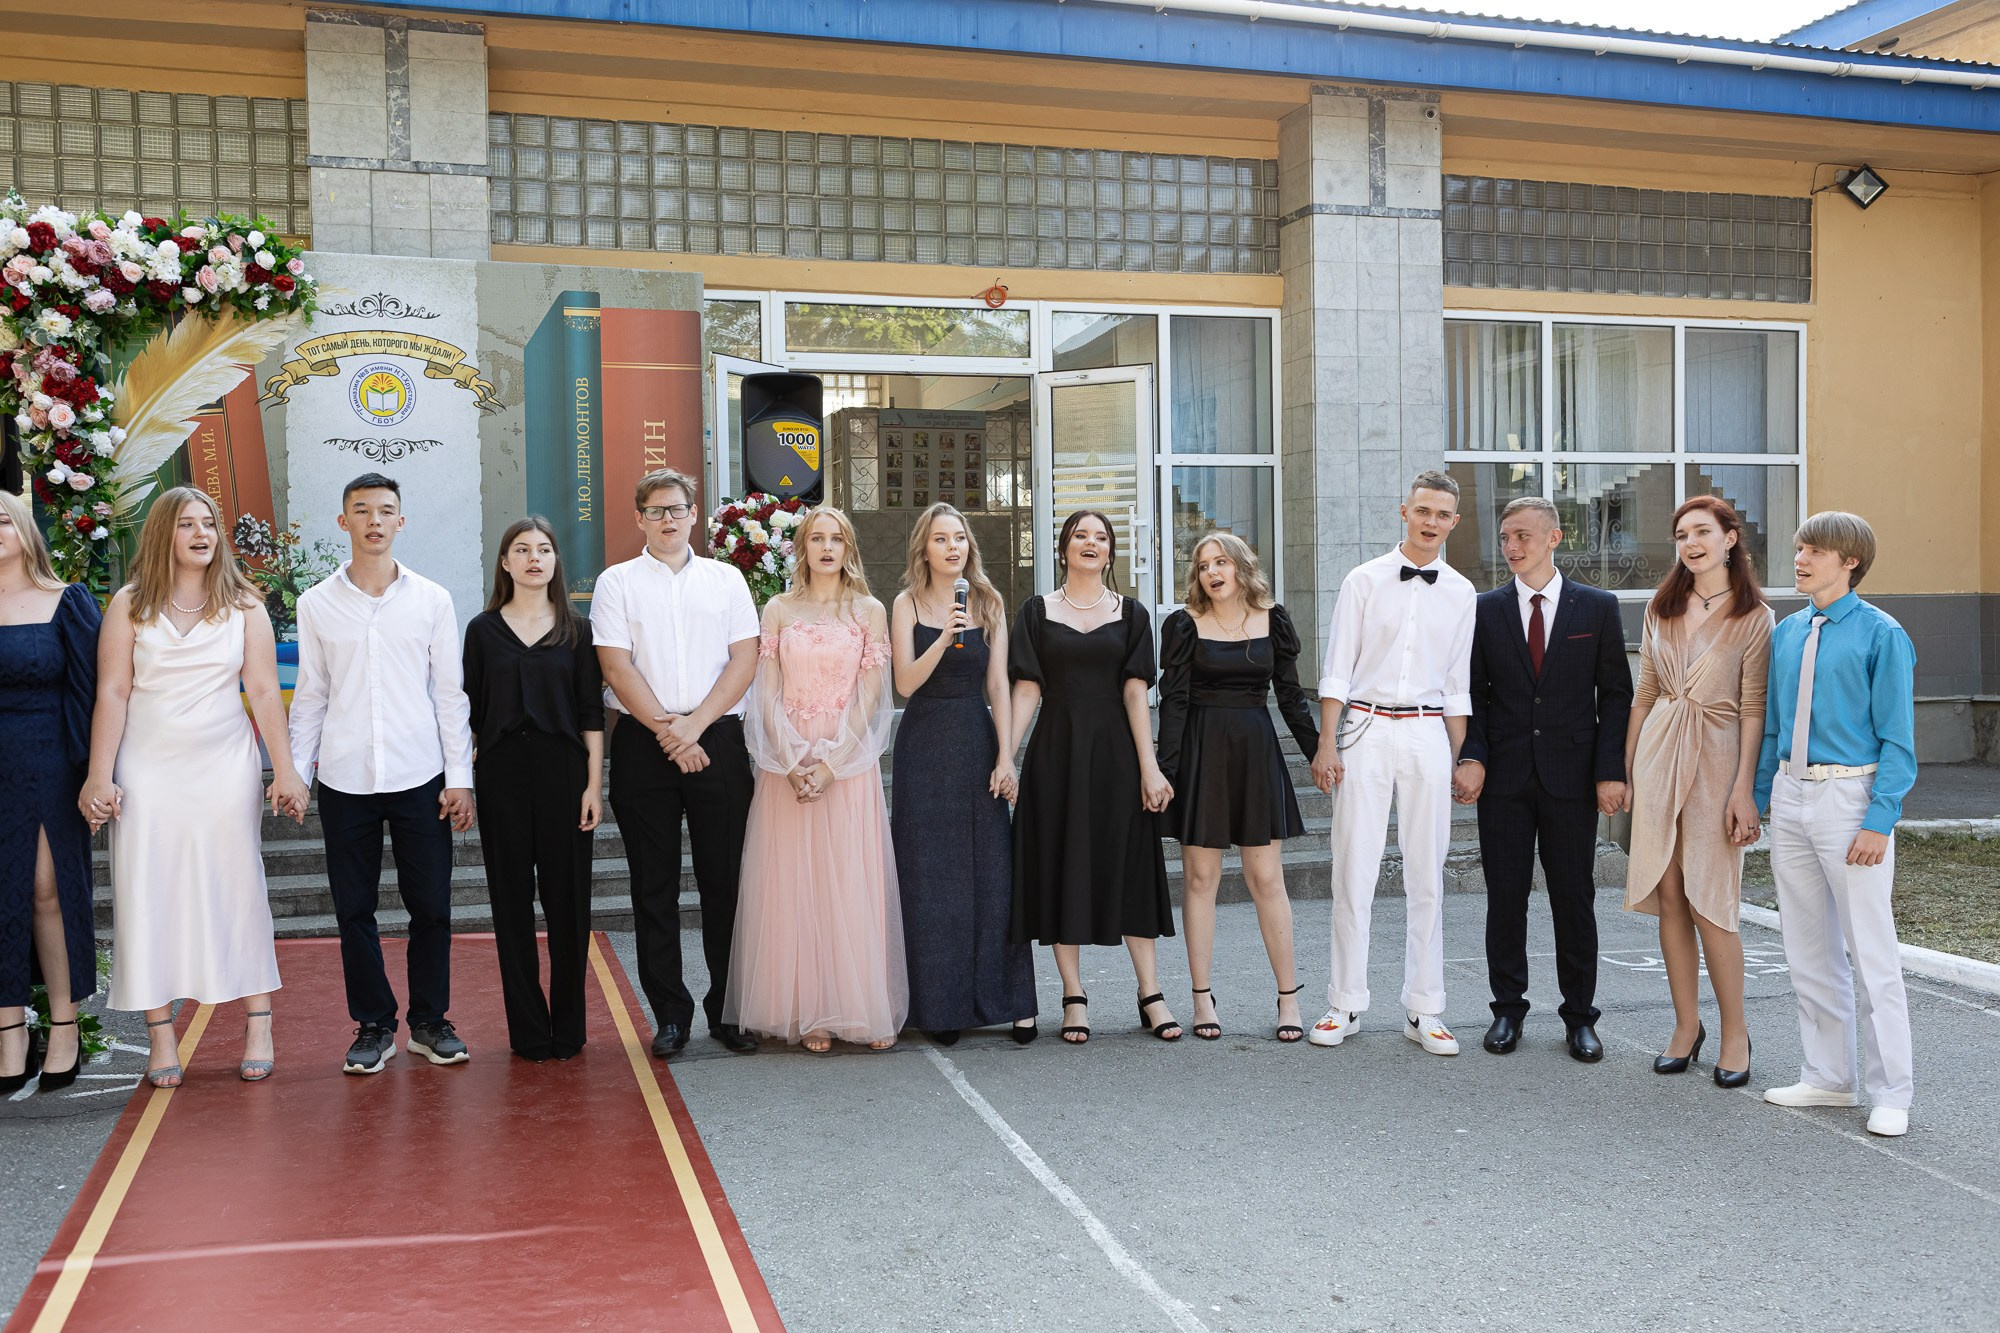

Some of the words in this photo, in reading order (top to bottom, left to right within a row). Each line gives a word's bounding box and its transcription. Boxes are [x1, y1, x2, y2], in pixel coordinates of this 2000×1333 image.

[306, 345, 321, 357] ТОТ
[321, 338, 349, 353] САМЫЙ
[350, 338, 372, 349] ДЕНЬ,
[372, 338, 409, 350] КОТОРОГО
[409, 341, 423, 351] МЫ
[357, 368, 370, 380] №8
[372, 416, 394, 424] ГБОУ
[200, 428, 217, 462] М.И.
[777, 432, 816, 446] 1000
[575, 377, 592, 522] М.Ю.ЛЕРМОНТОВ
